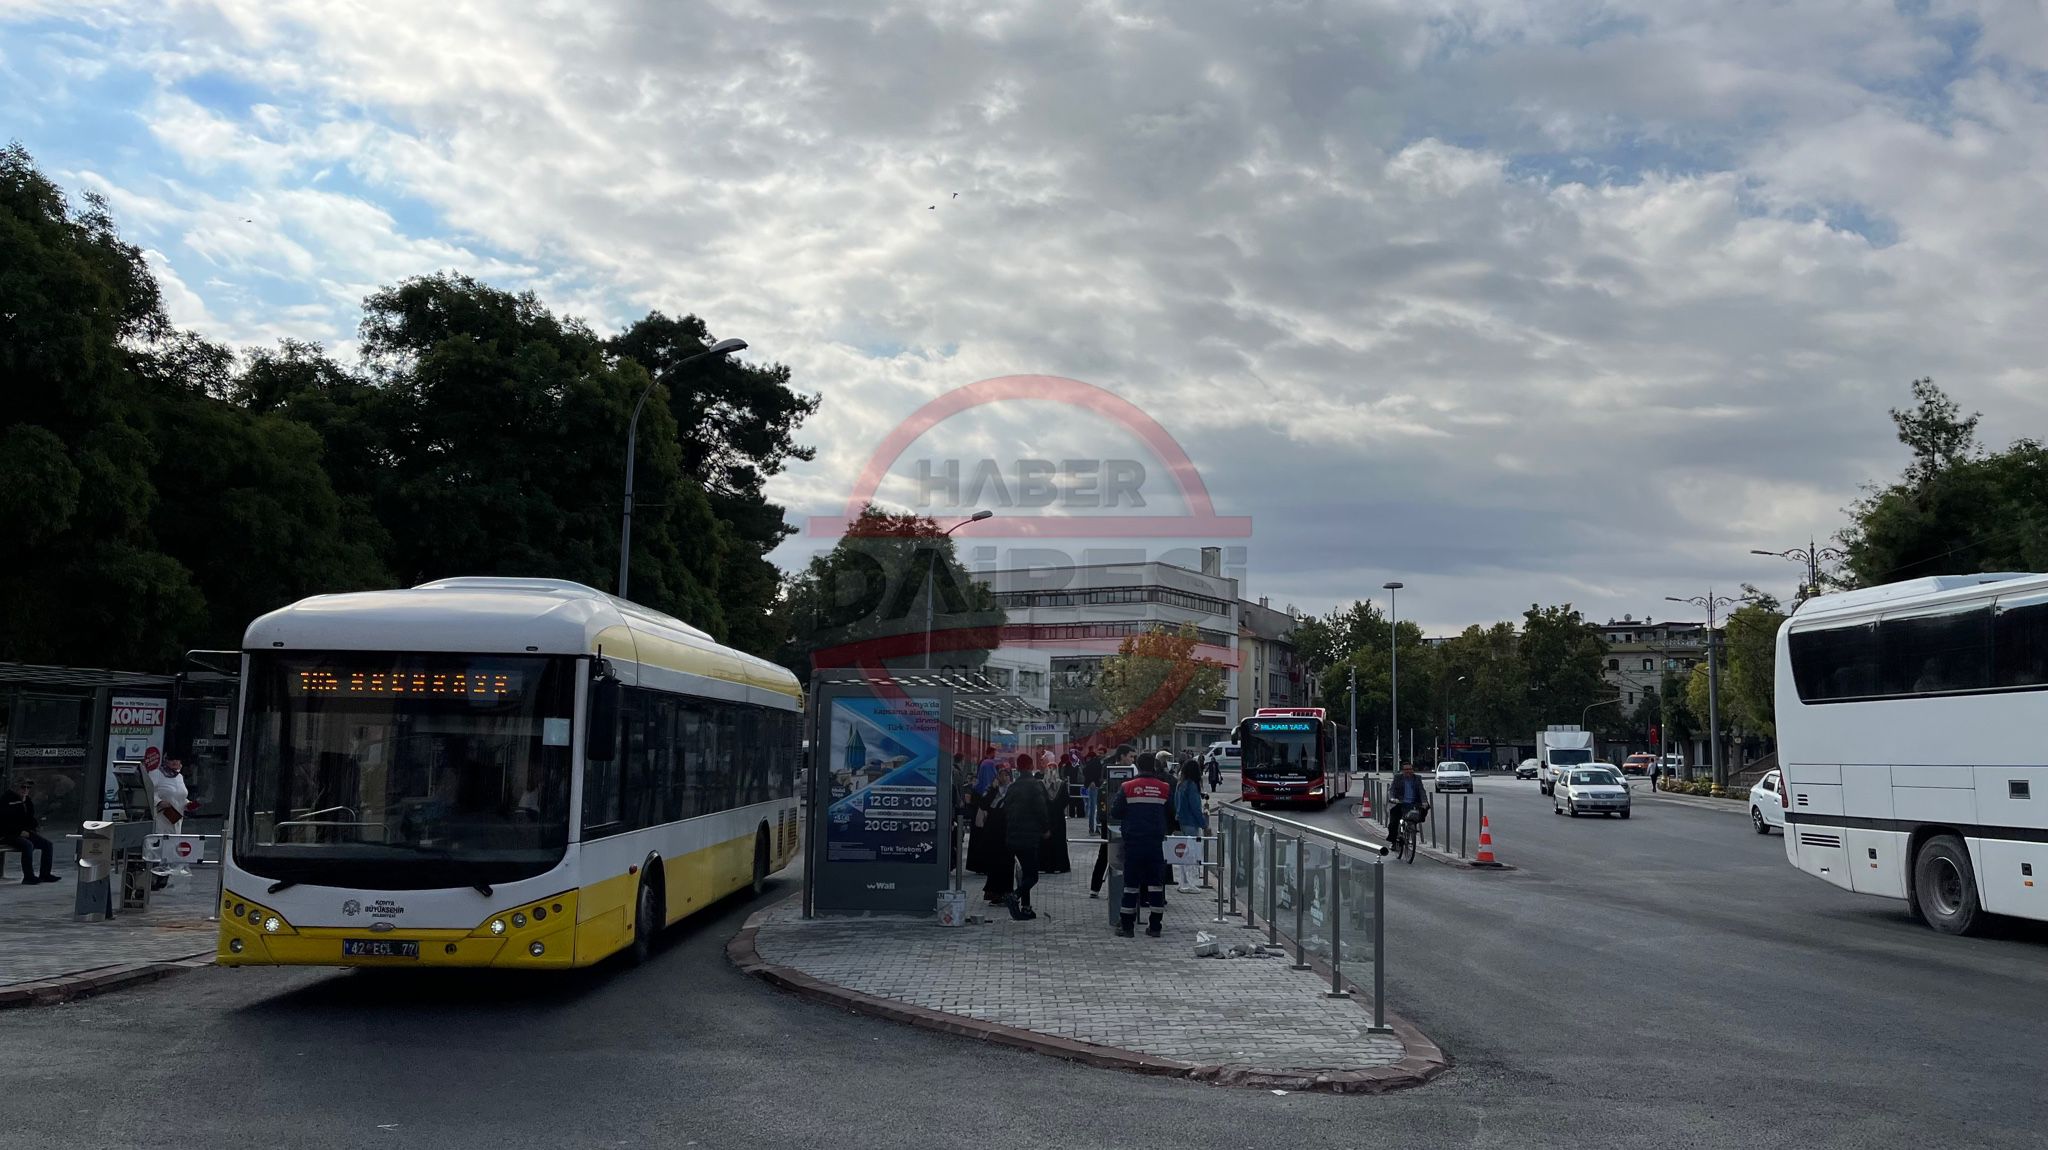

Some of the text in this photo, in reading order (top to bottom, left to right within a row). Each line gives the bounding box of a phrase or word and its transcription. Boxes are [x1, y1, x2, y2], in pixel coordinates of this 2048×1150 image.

[111, 707, 161, 725] KOMEK
[910, 796, 932, 808] 100
[908, 820, 930, 832] 120
[351, 942, 365, 954] 42
